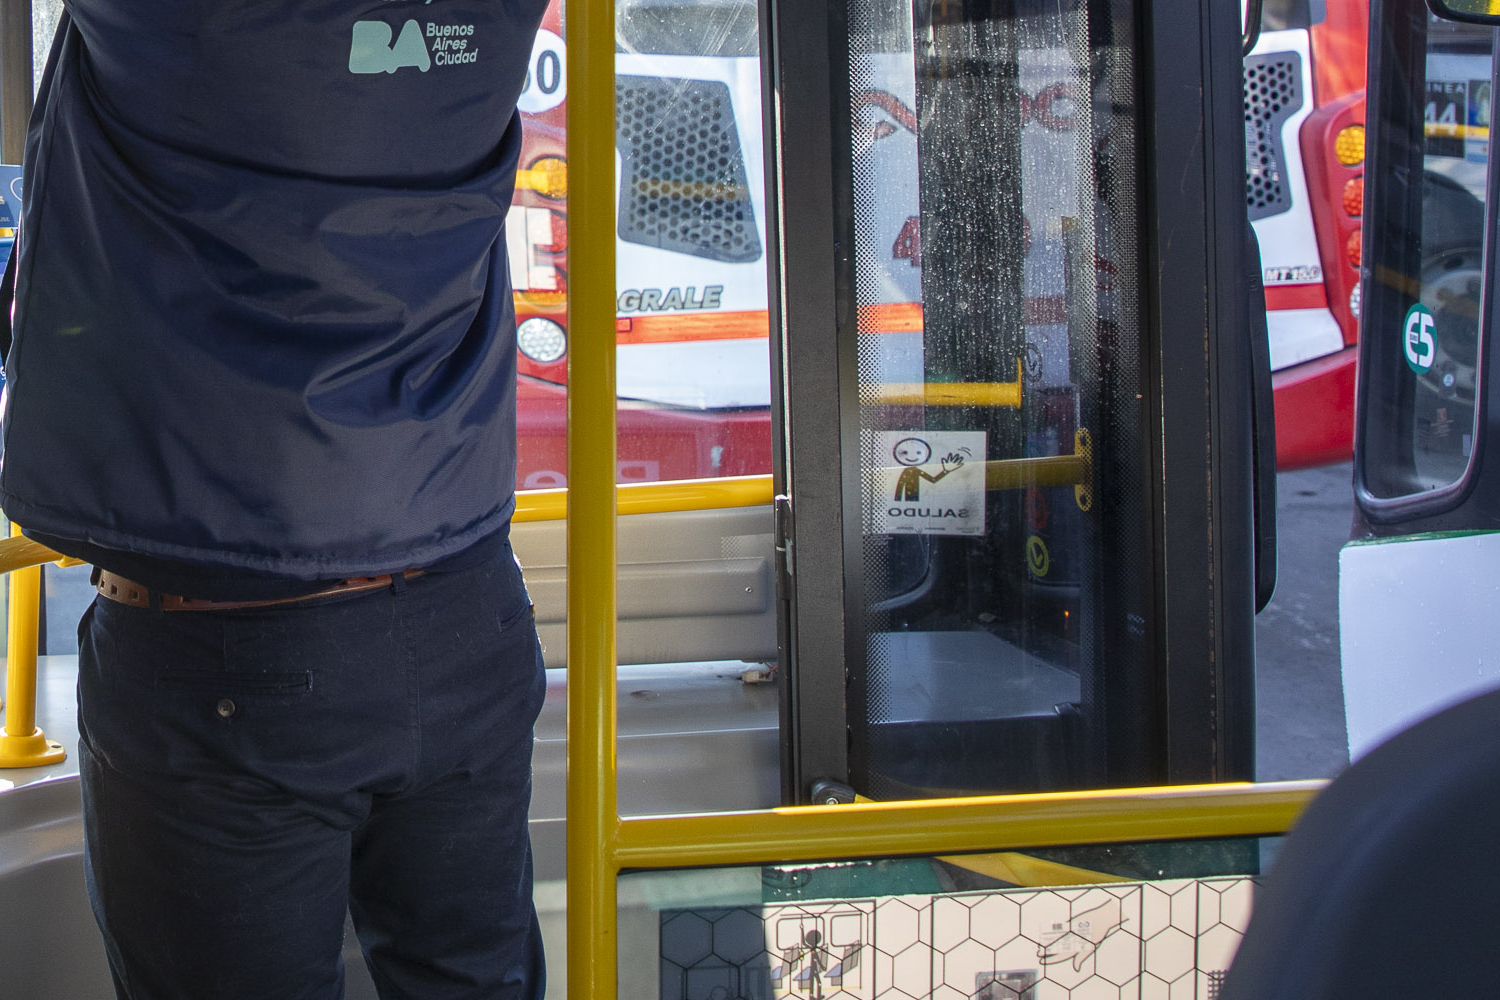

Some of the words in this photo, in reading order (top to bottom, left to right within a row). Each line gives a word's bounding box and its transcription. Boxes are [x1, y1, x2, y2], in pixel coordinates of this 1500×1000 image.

[426, 22, 474, 37] Buenos
[349, 19, 431, 74] BA
[432, 37, 467, 51] Aires
[435, 48, 478, 65] Ciudad
[521, 49, 561, 95] 0
[1426, 83, 1465, 94] INEA
[616, 285, 724, 312] GRALE
